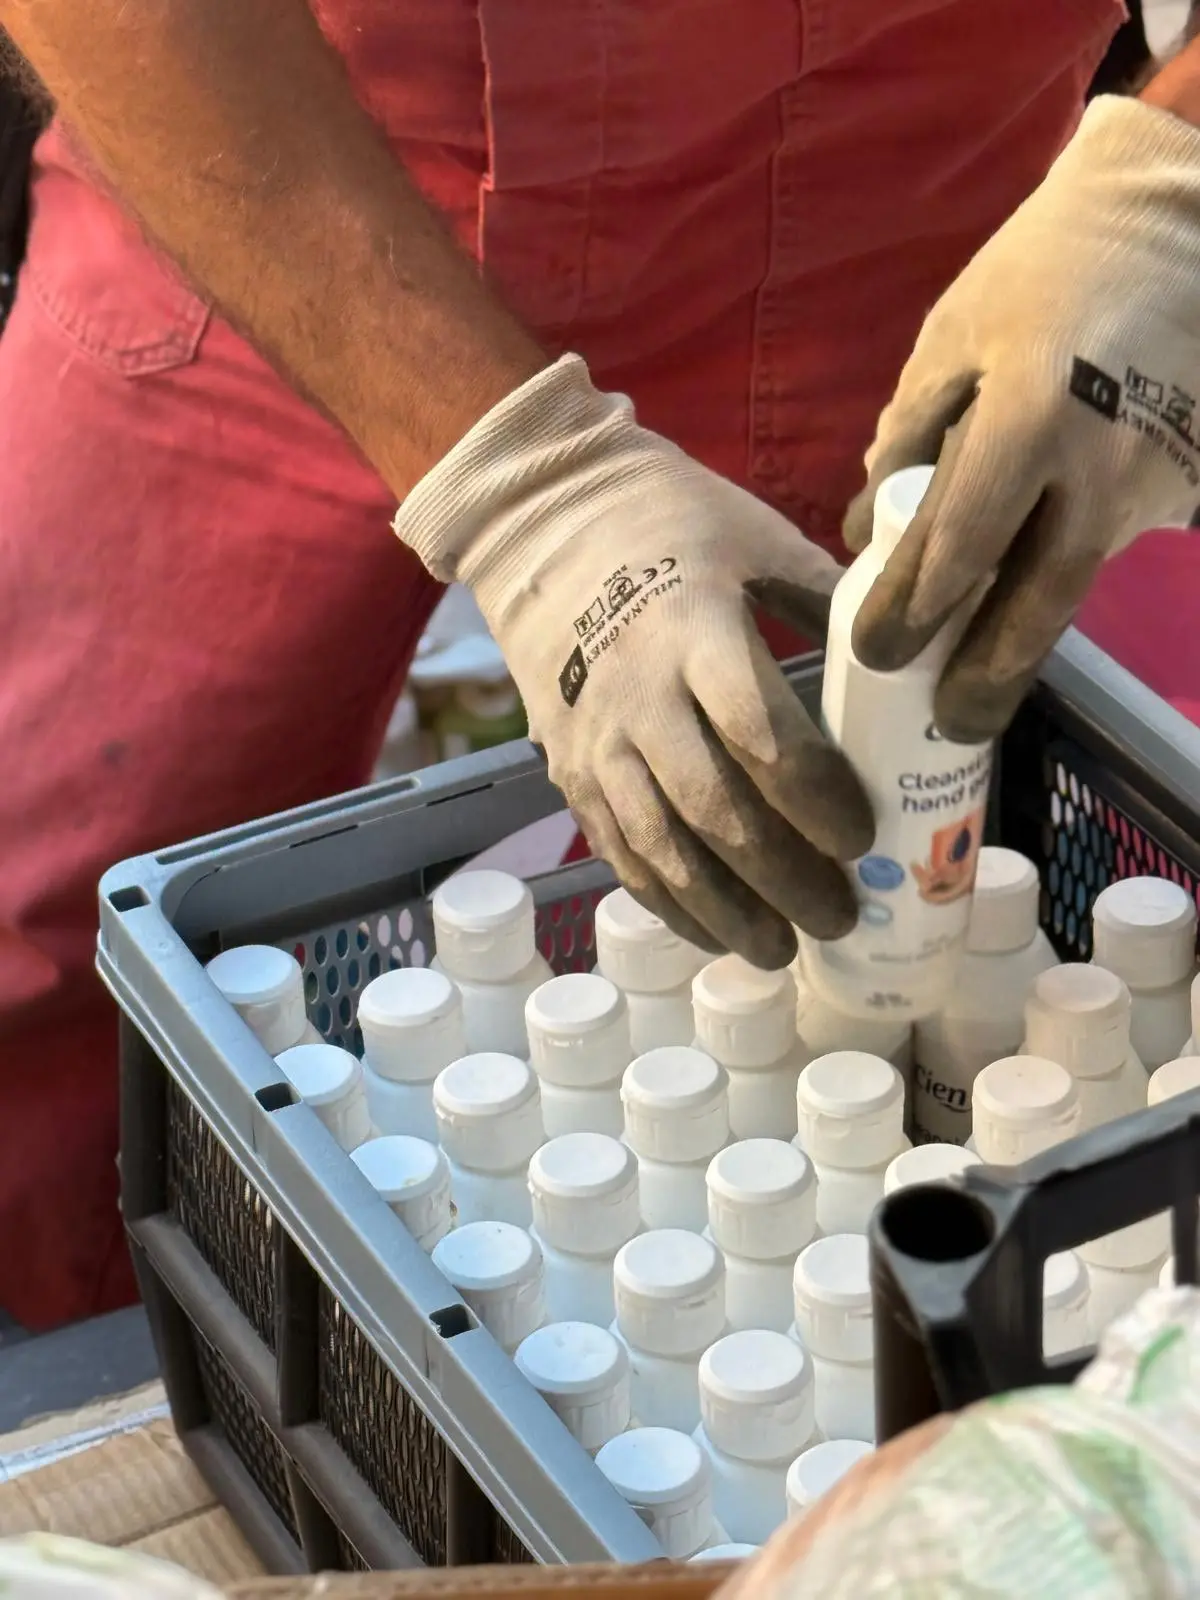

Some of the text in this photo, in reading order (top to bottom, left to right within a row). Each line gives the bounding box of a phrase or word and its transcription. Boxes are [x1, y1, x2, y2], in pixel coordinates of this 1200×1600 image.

[620, 574, 683, 627] MILANA
[585, 625, 620, 667] GREY
[902, 784, 965, 813] hand
[914, 1063, 967, 1107] Cien
